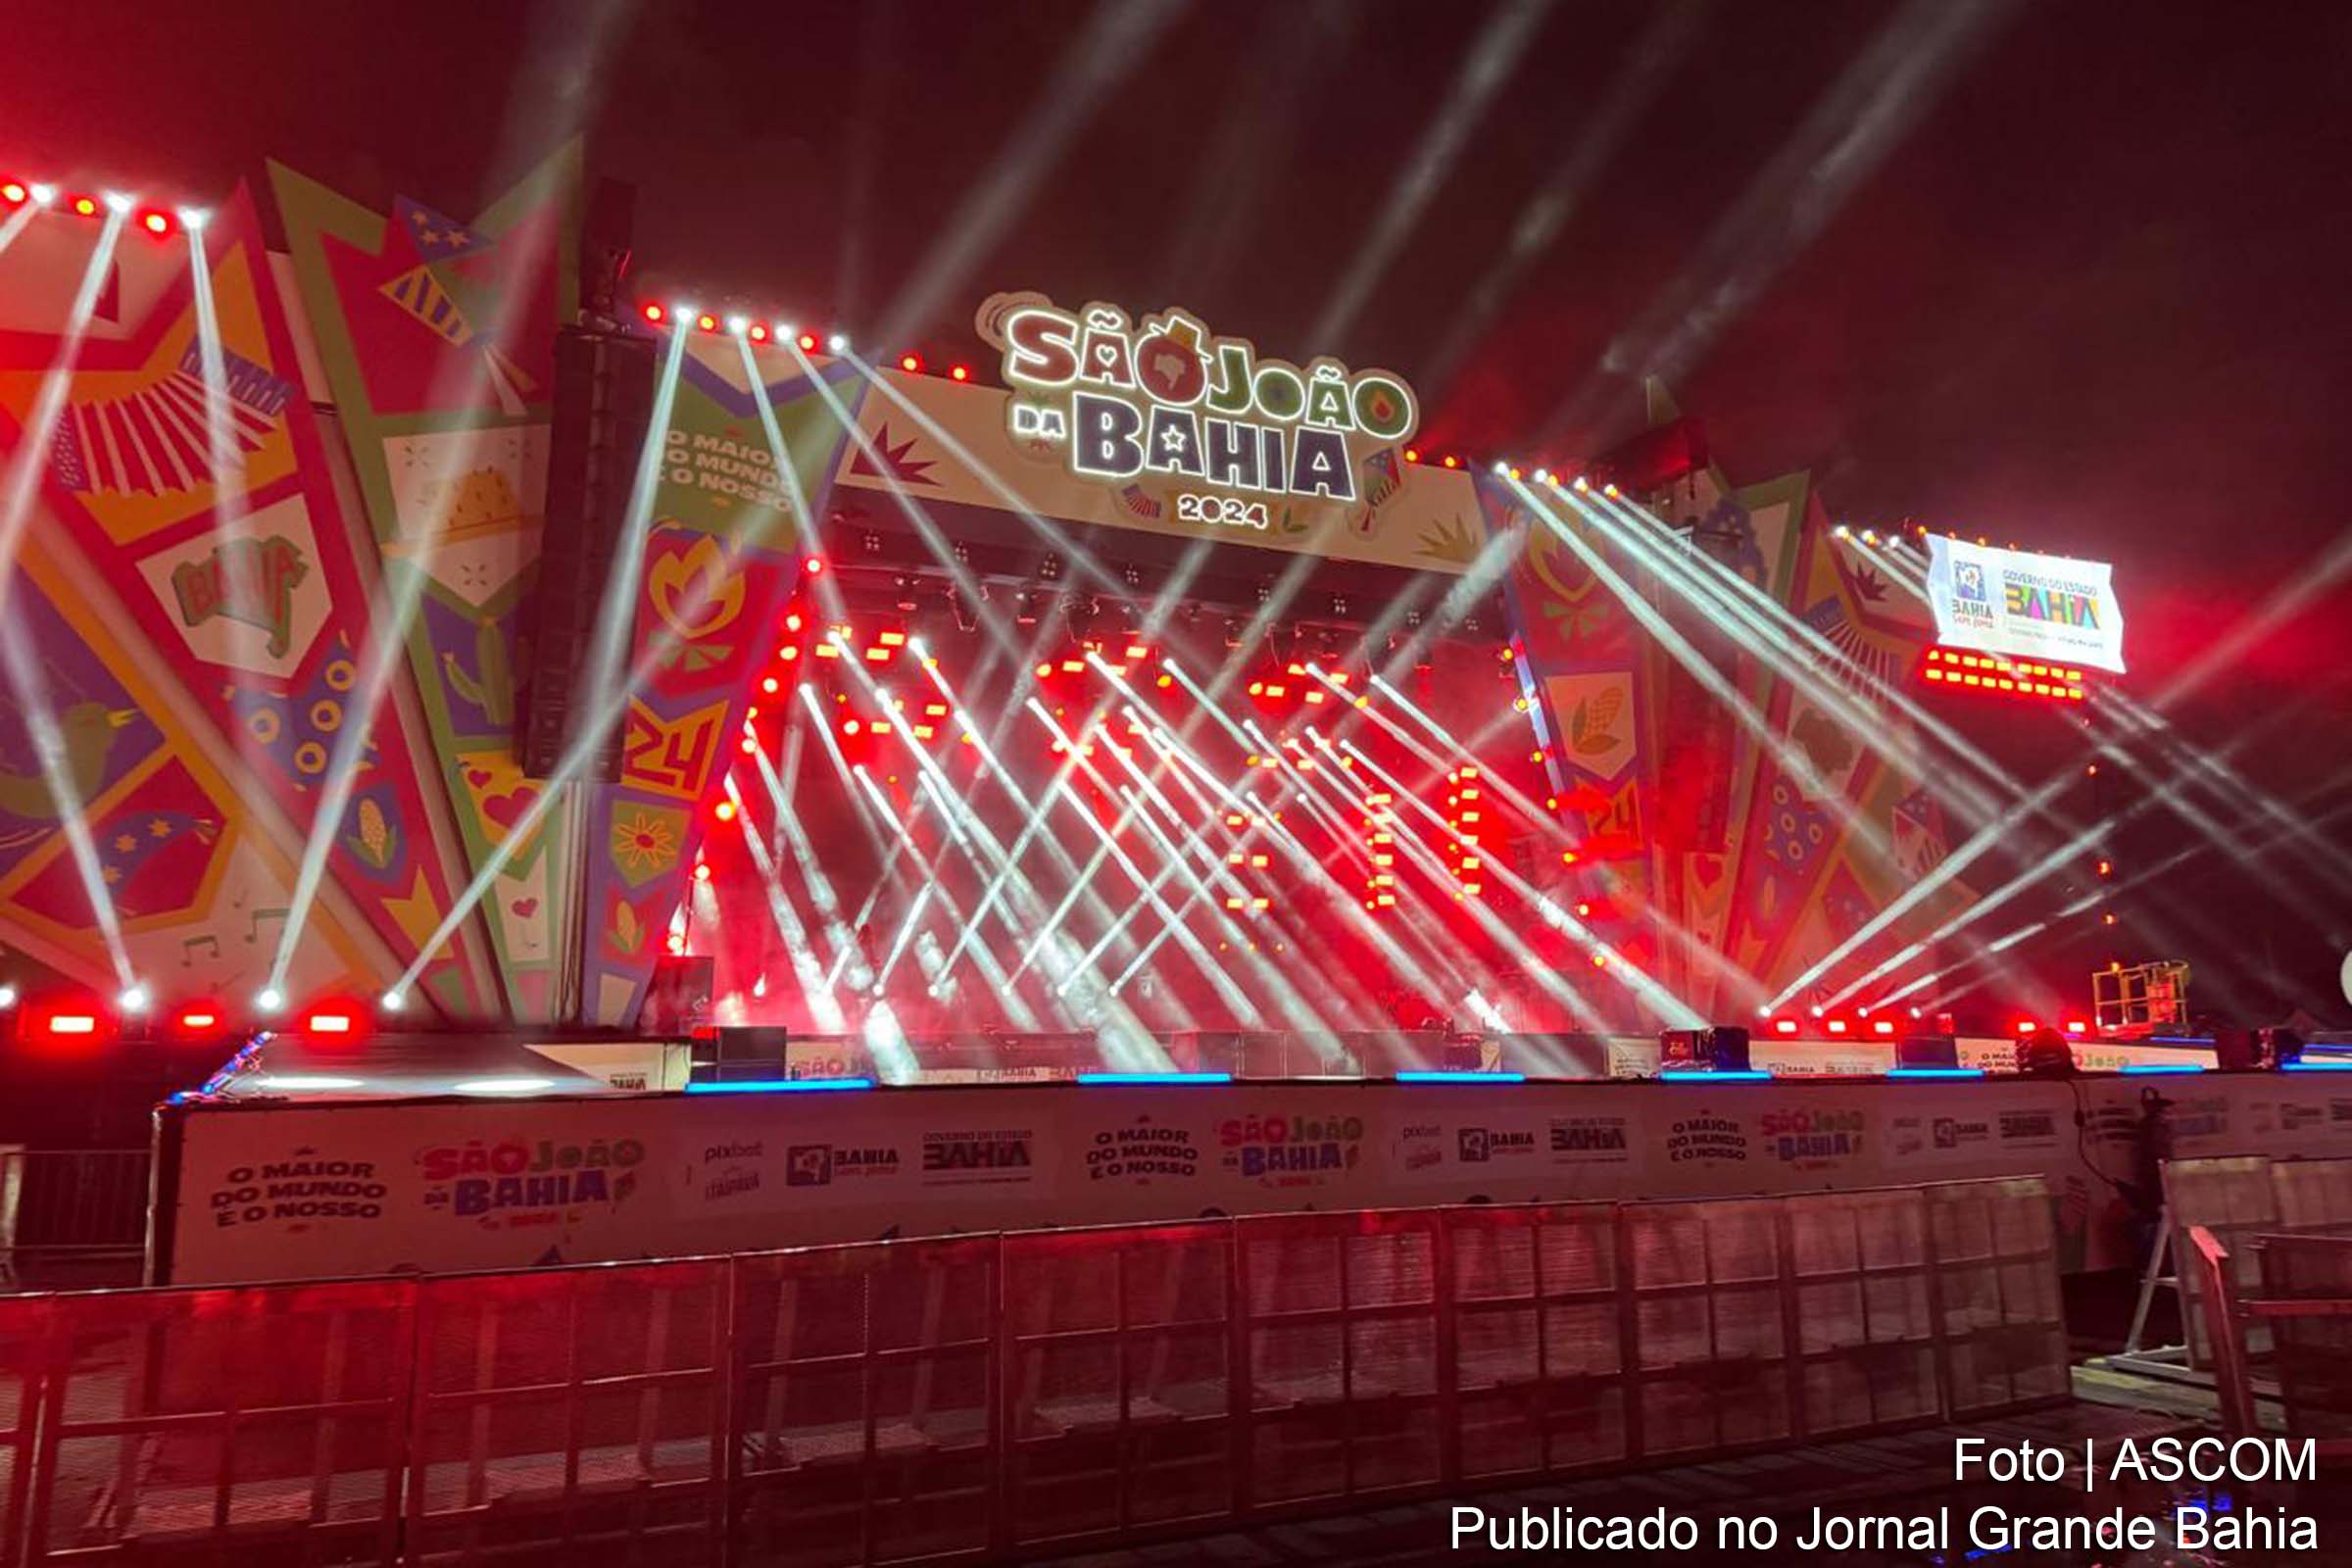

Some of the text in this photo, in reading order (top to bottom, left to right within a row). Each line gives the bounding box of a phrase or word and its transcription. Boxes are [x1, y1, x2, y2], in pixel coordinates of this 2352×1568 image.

[1006, 308, 1211, 407] SÃO
[666, 429, 688, 445] O
[1012, 390, 1357, 502] DA BAHIA
[671, 467, 694, 485] O
[698, 471, 793, 513] NOSSO
[1177, 492, 1269, 529] 2024
[2004, 581, 2100, 630] BAHIA
[1095, 1127, 1190, 1146] O MAIOR
[1219, 1113, 1288, 1147] SÃO
[1672, 1118, 1740, 1135] O MAIOR
[1490, 1132, 1537, 1147] BAHIA
[1666, 1135, 1690, 1151] DO
[1690, 1133, 1747, 1149] MUNDO
[1777, 1133, 1851, 1161] BAHIA
[422, 1139, 529, 1182] SÃO
[834, 1149, 900, 1166] BAHIA
[1086, 1144, 1199, 1165] DO MUNDO
[1241, 1142, 1344, 1178] BAHIA
[1682, 1148, 1694, 1160] O
[1695, 1147, 1747, 1161] NOSSO
[227, 1160, 375, 1183] O MAIOR
[1105, 1162, 1123, 1176] O
[1126, 1159, 1197, 1177] NOSSO
[210, 1181, 387, 1208] DO MUNDO
[455, 1169, 610, 1217] BAHIA
[242, 1205, 268, 1222] O
[273, 1201, 381, 1219] NOSSO
